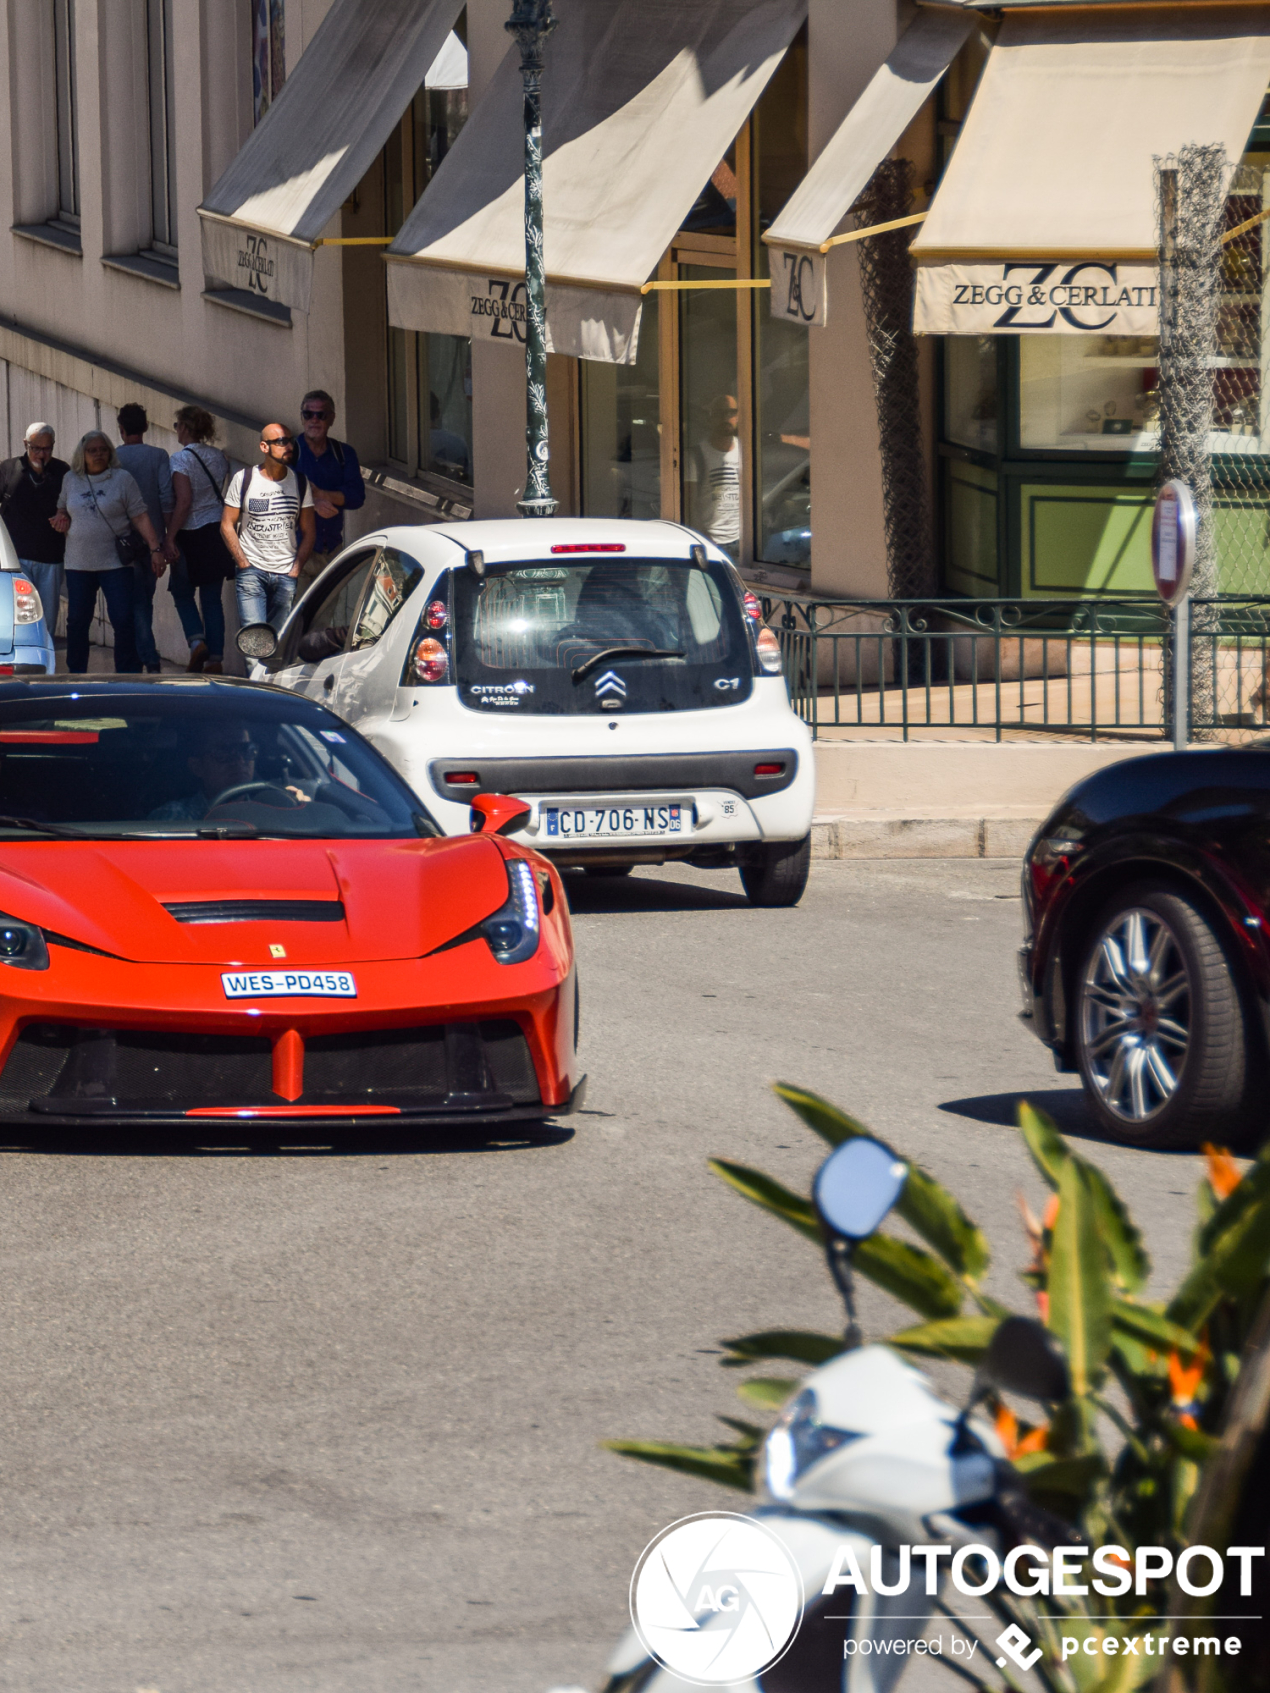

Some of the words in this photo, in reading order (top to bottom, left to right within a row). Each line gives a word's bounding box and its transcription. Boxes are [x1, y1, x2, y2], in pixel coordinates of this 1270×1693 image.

[952, 285, 1023, 305] ZEGG
[1027, 285, 1047, 306] &
[1049, 285, 1157, 307] CERLATI
[471, 296, 500, 317] ZEGG
[501, 300, 508, 319] &
[470, 684, 534, 694] CITRON
[714, 678, 739, 690] C1
[670, 820, 681, 830] 06
[227, 975, 350, 991] WES-PD458
